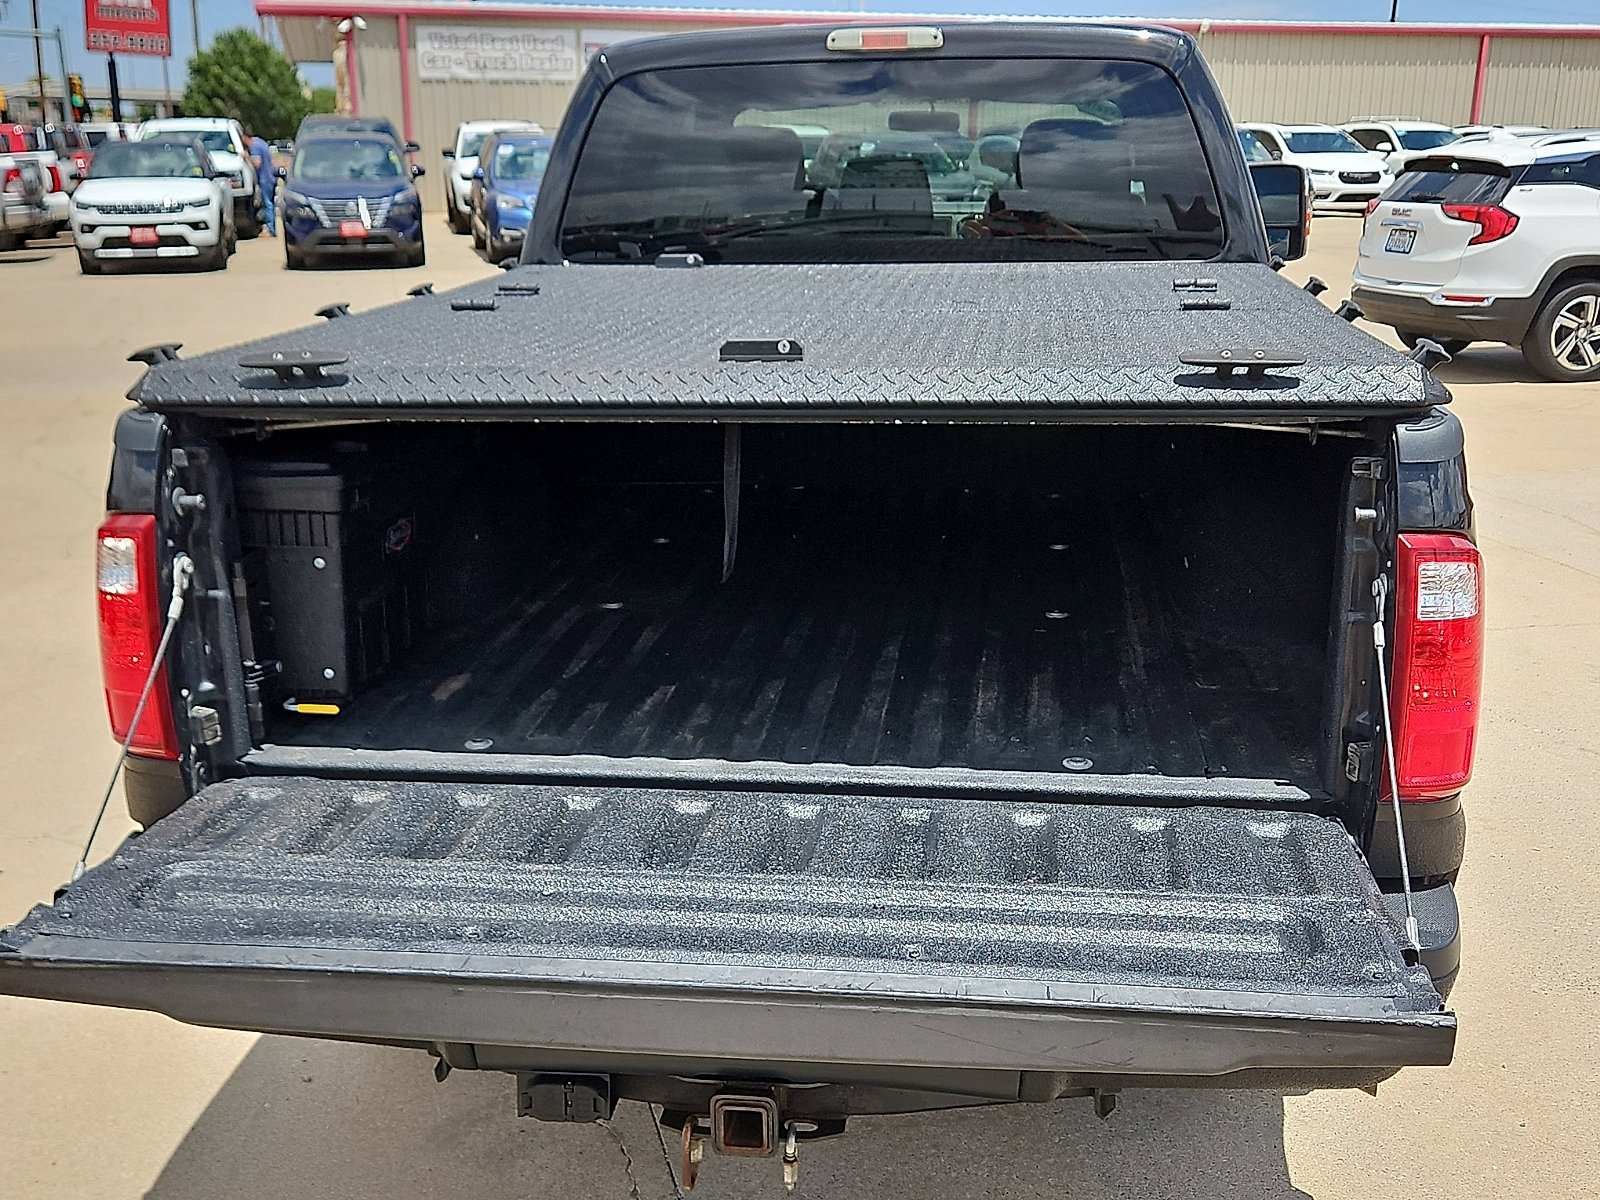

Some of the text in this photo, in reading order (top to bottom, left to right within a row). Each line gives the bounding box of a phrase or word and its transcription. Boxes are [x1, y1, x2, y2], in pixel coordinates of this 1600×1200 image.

[521, 34, 564, 52] Used
[421, 51, 451, 69] Car
[464, 52, 518, 70] Truck
[519, 53, 574, 72] Dealer
